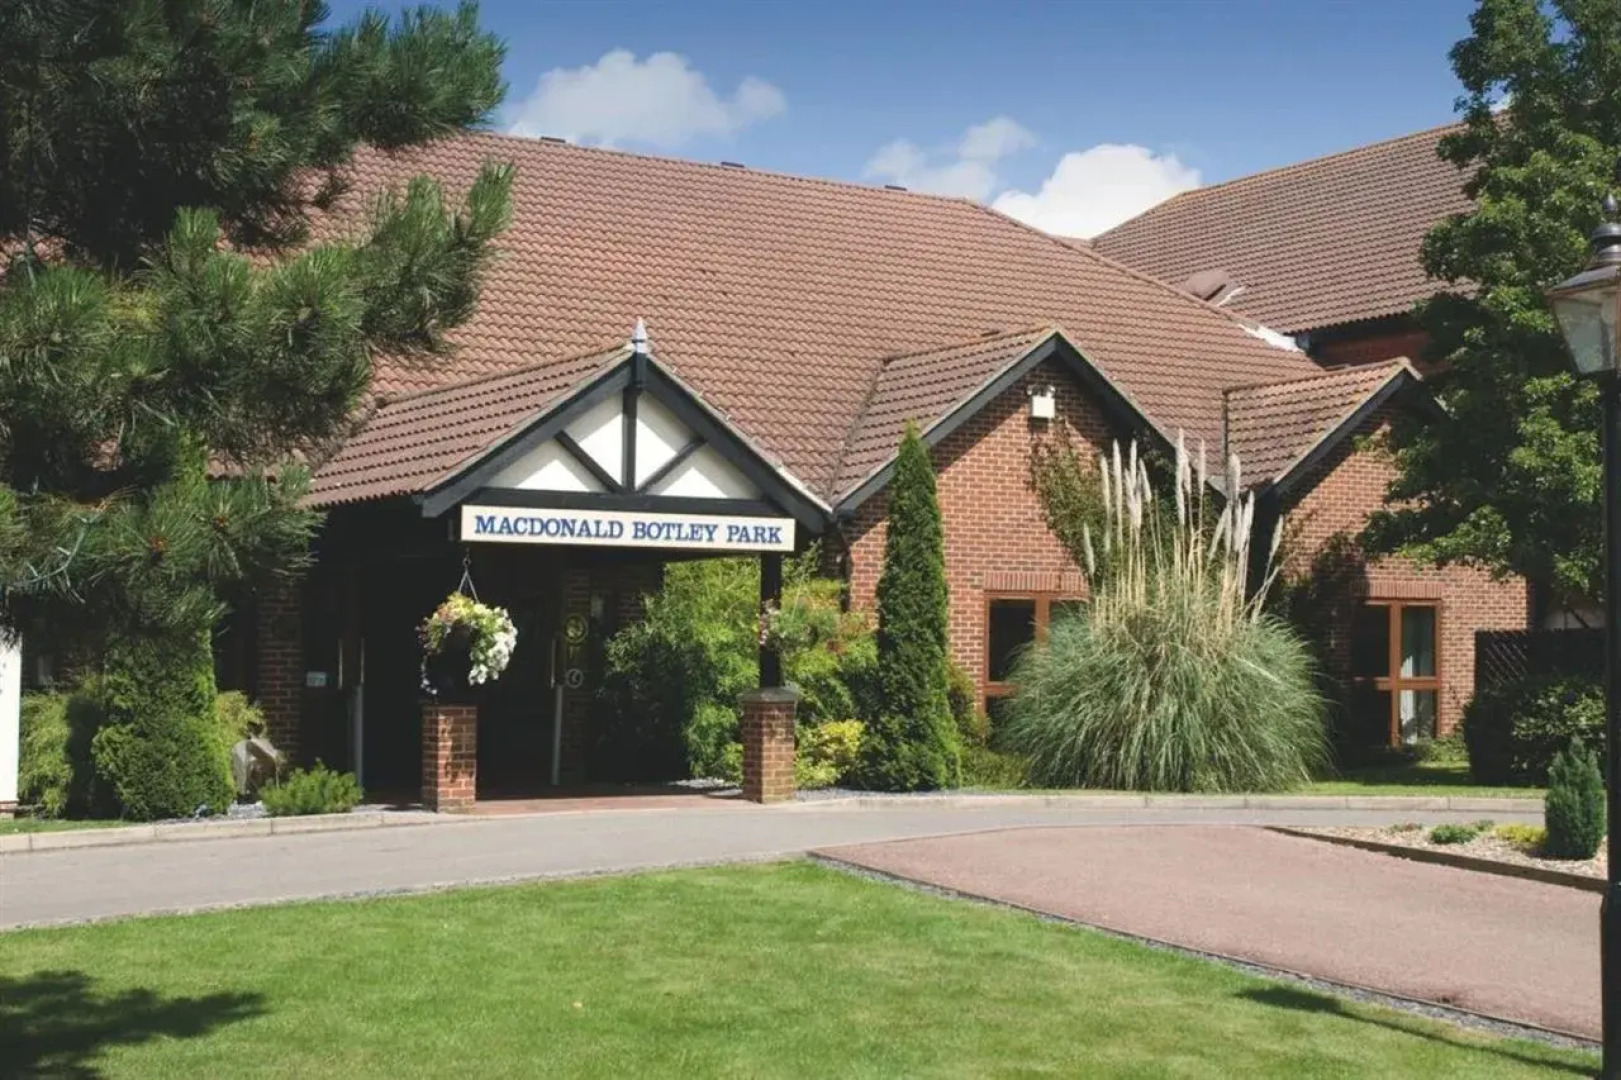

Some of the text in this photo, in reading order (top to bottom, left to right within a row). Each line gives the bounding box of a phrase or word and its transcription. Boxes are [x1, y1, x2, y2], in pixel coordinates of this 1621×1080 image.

[474, 515, 782, 544] MACDONALD BOTLEY PARK
